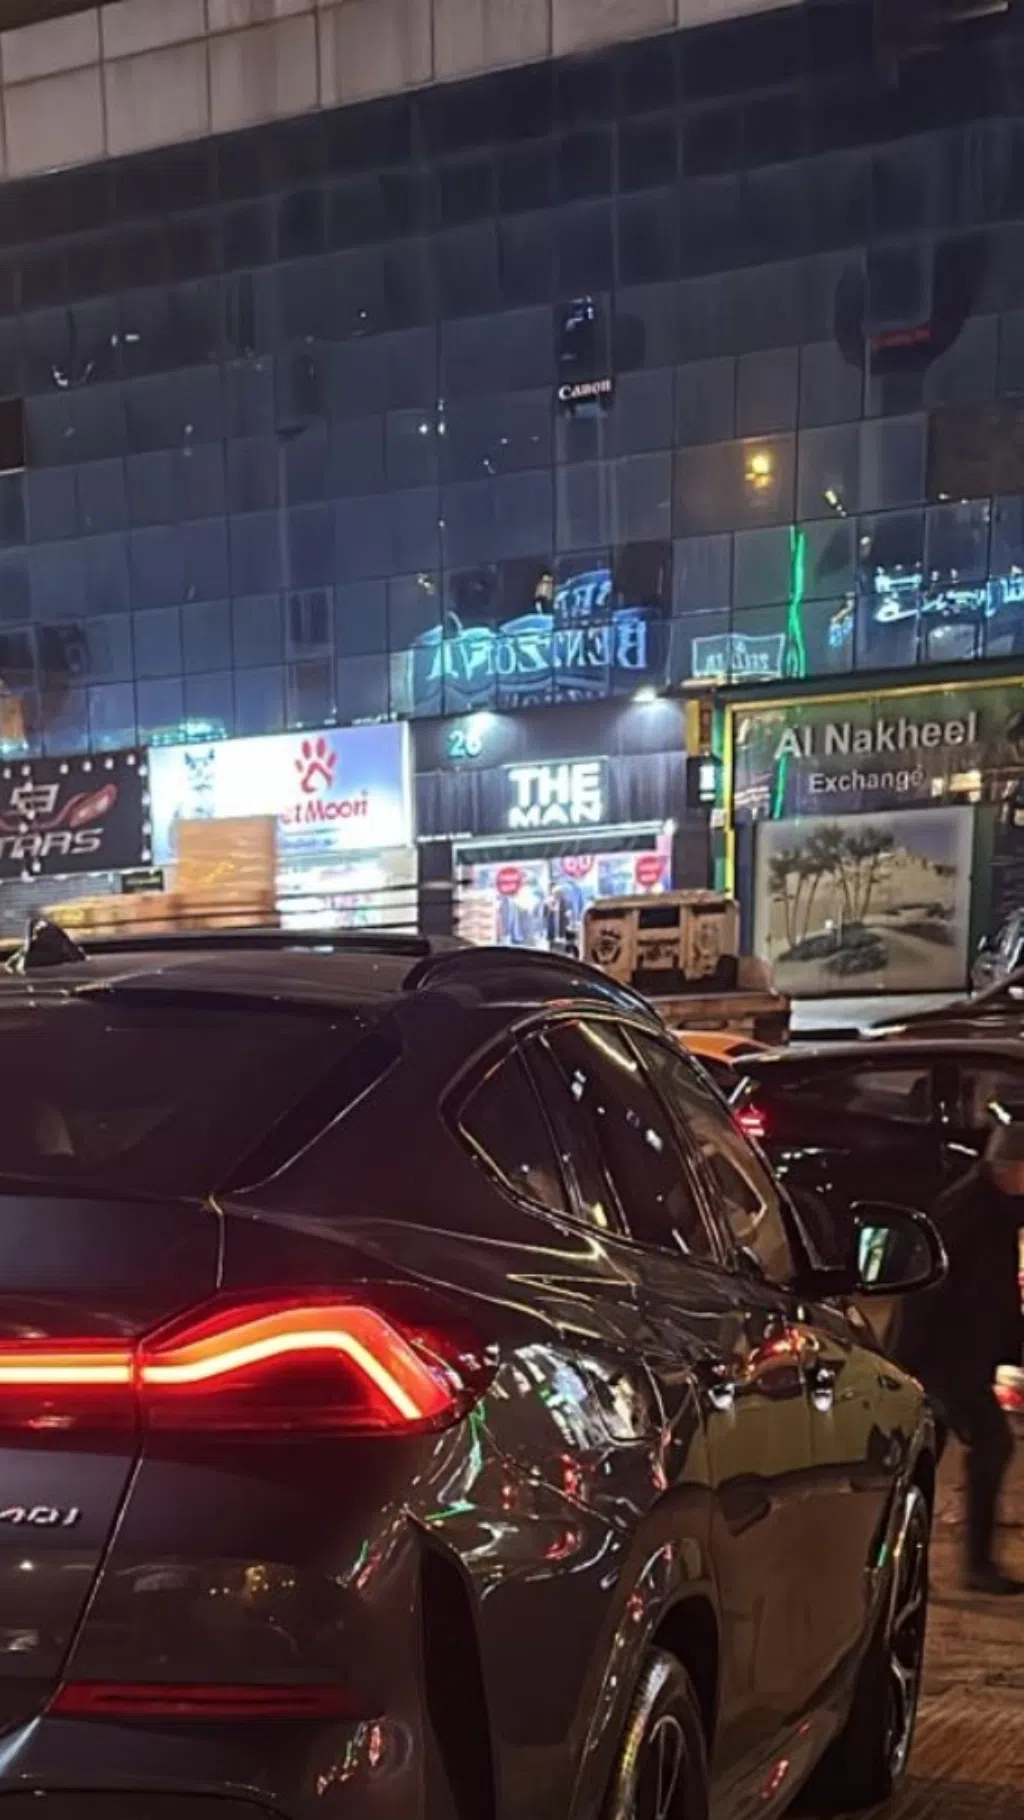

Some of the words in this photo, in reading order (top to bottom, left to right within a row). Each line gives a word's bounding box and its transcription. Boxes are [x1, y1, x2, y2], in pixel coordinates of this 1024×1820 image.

[774, 725, 812, 759] Al
[825, 712, 977, 756] Nakheel
[507, 762, 602, 807] THE
[808, 767, 925, 793] Exchange
[507, 801, 603, 829] MAN
